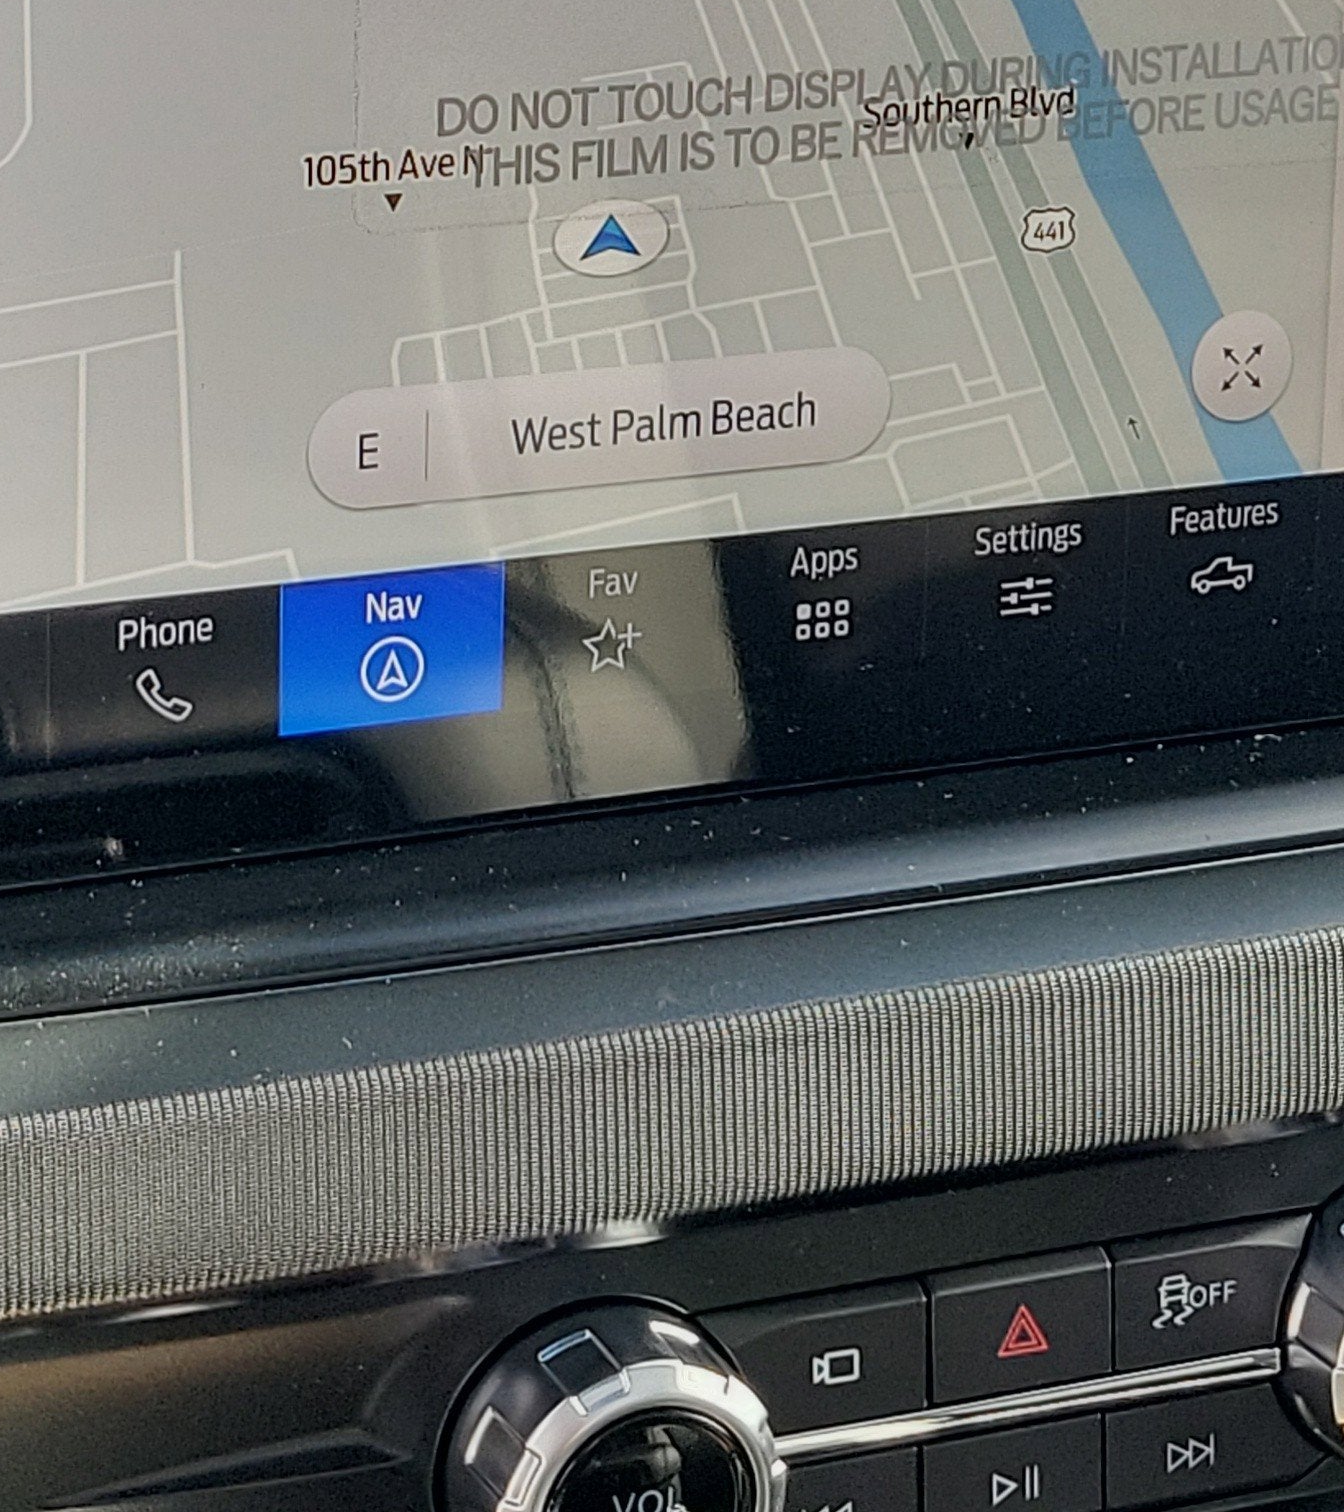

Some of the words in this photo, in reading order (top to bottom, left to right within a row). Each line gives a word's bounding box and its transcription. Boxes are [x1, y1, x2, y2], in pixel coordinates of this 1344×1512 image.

[436, 94, 499, 138] DO
[509, 86, 599, 131] NOT
[606, 76, 753, 125] TOUCH
[763, 62, 926, 113] DISPLAY
[940, 51, 1093, 98] DURING
[863, 91, 1003, 129] Southern
[1009, 82, 1076, 121] Blvd
[469, 144, 560, 187] THIS
[570, 136, 667, 182] FILM
[680, 131, 715, 172] IS
[723, 124, 780, 168] TO
[789, 120, 843, 162] BE
[852, 100, 1046, 159] REMOVED
[1056, 94, 1207, 143] BEFORE
[1213, 84, 1339, 131] USAGE
[303, 152, 392, 187] 105th
[397, 149, 455, 181] Ave
[1032, 220, 1067, 244] 441
[358, 433, 380, 470] E
[511, 414, 602, 456] West
[611, 402, 702, 446] Palm
[711, 391, 817, 433] Beach
[1169, 499, 1280, 537] Features
[974, 519, 1083, 556] Settings
[790, 541, 859, 582] Apps
[587, 568, 638, 599] Fav
[365, 592, 423, 623] Nav
[116, 616, 215, 652] Phone
[1188, 1279, 1237, 1308] OFF
